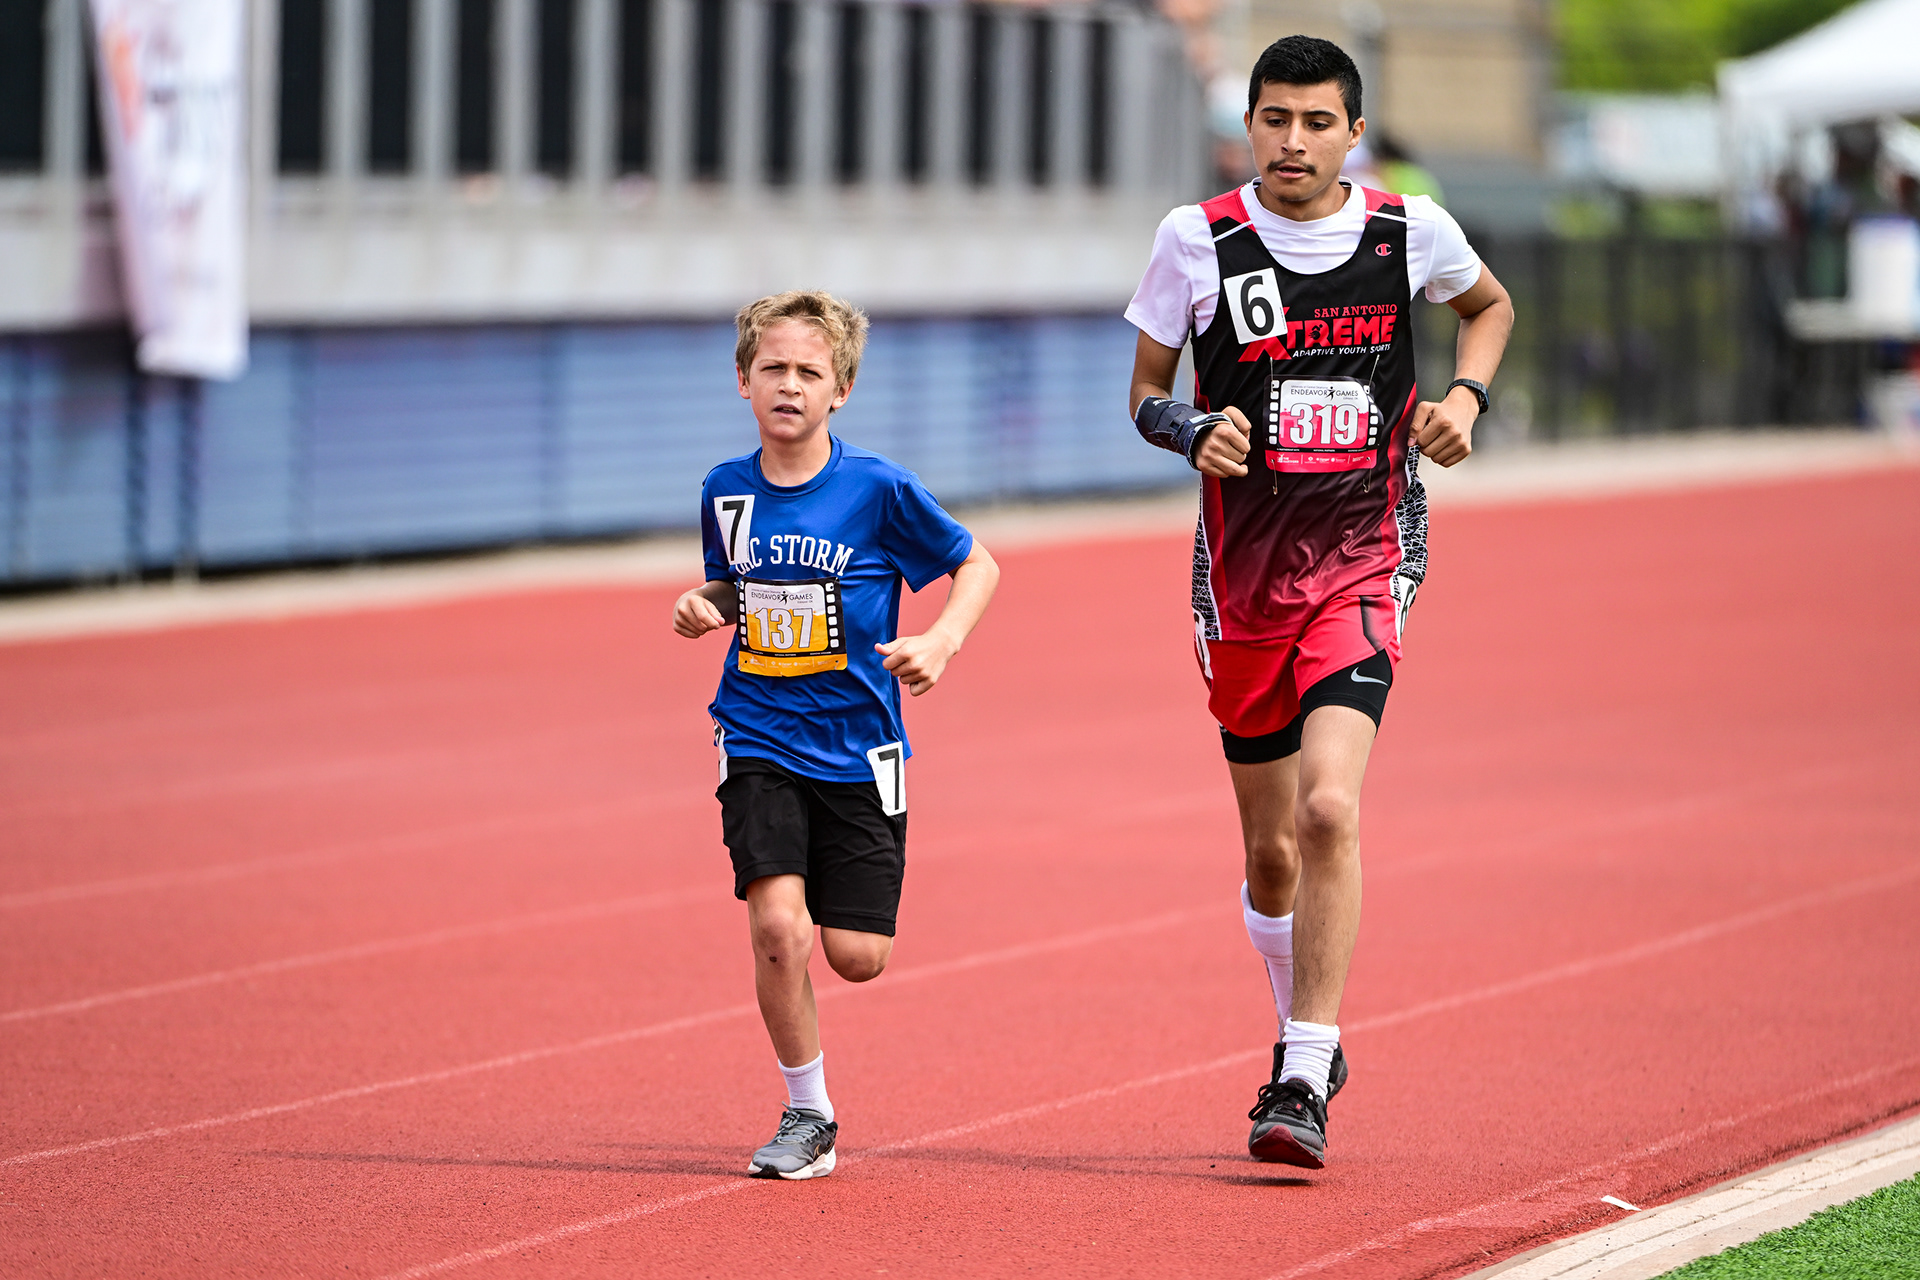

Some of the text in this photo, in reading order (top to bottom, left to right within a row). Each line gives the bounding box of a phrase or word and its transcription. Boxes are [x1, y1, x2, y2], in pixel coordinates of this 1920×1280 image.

[1240, 275, 1275, 337] 6
[1314, 303, 1398, 318] SAN ANTONIO
[1292, 347, 1334, 358] ADAPTIVE
[1338, 346, 1367, 355] YOUTH
[1290, 388, 1359, 397] ENDEAVOR GAMES
[1289, 403, 1359, 446] 319
[722, 500, 746, 562] 7
[769, 534, 855, 577] STORM
[751, 591, 814, 601] ENDEAVOR GAMES
[755, 607, 814, 650] 137
[877, 748, 900, 811] 7
